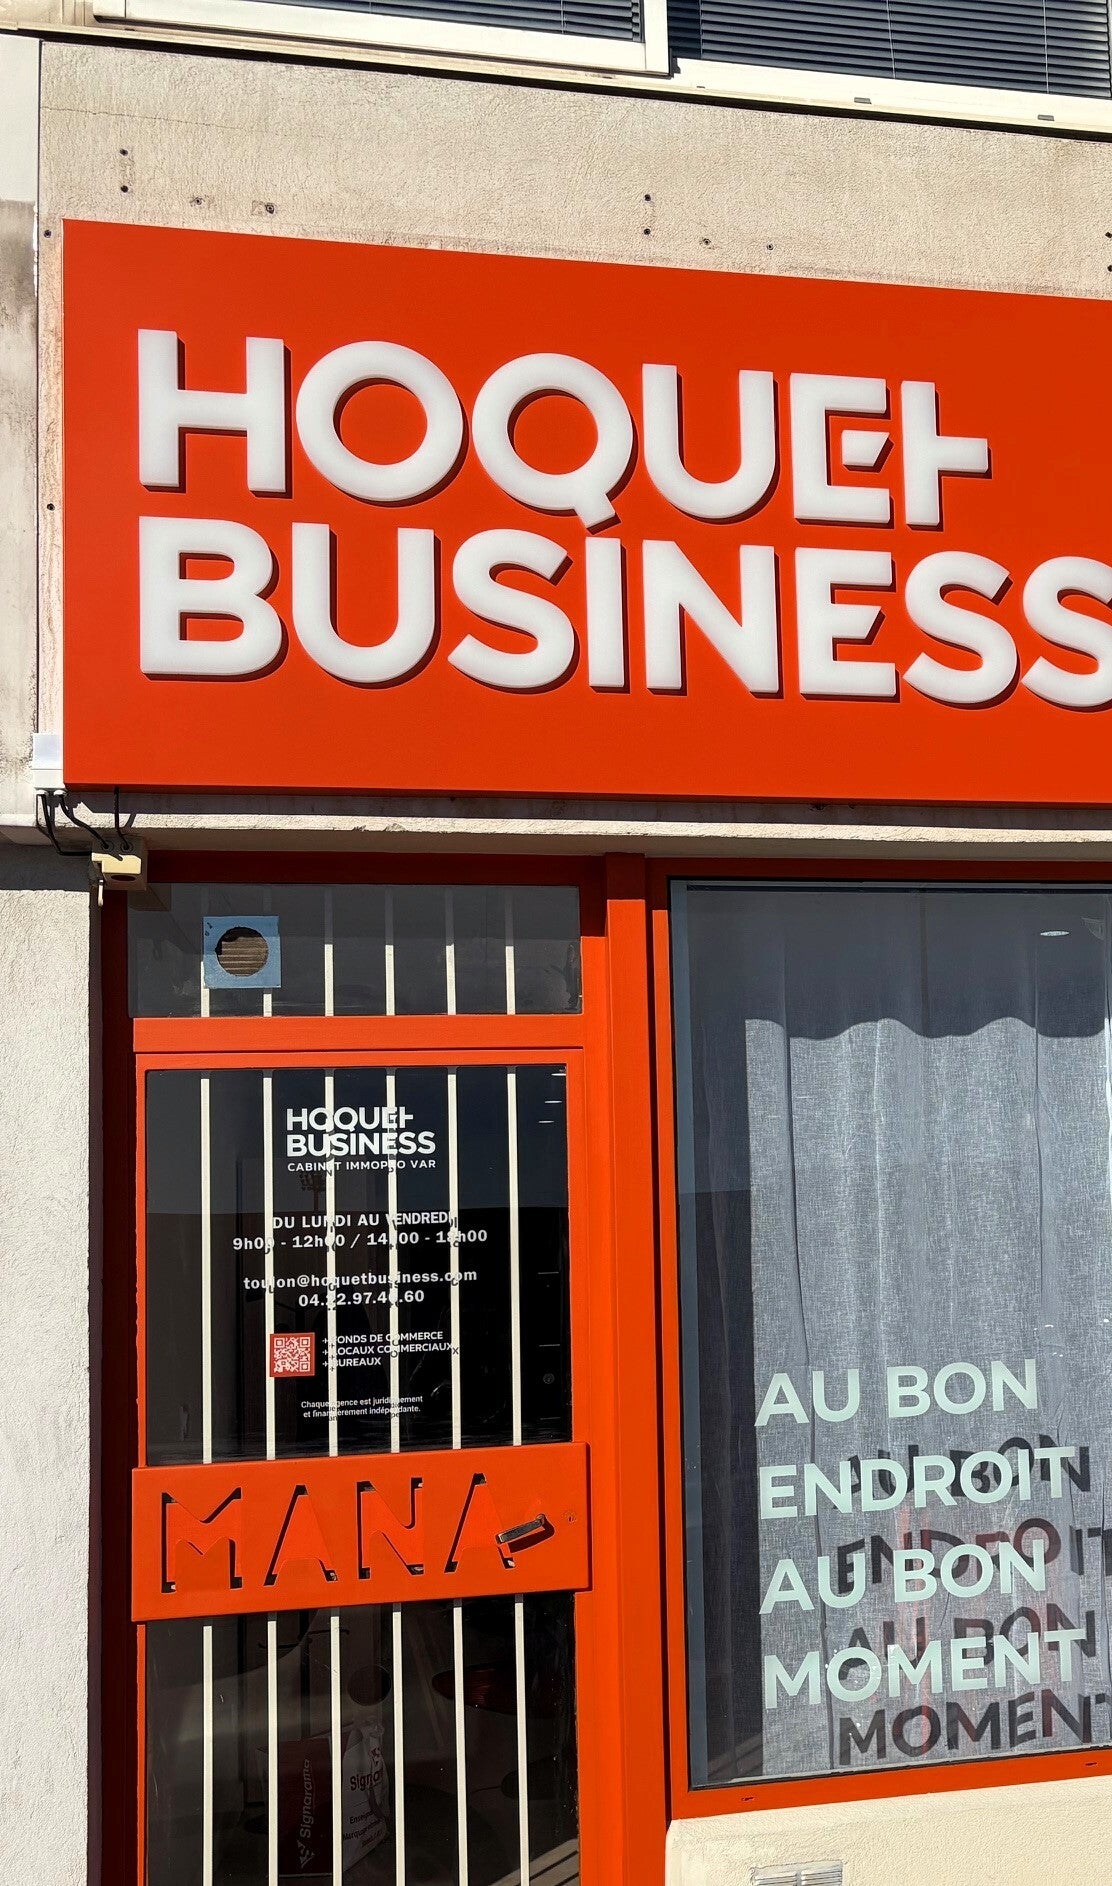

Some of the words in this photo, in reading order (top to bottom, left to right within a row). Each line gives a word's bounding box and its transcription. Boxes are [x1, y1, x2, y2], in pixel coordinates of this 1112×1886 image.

[286, 1131, 436, 1157] BUSINESS
[287, 1161, 341, 1172] CABINT
[346, 1160, 406, 1170] IMMOPO
[410, 1160, 436, 1169] VAR
[273, 1216, 295, 1229] DU
[357, 1214, 380, 1226] AU
[367, 1231, 419, 1246] 1400
[333, 1334, 367, 1344] ONDS
[369, 1333, 383, 1343] DE
[385, 1331, 443, 1342] CMMERCE
[333, 1346, 375, 1356] OCAUX
[377, 1342, 454, 1354] COMERCIAUX
[754, 1368, 860, 1427] AU
[886, 1358, 1038, 1418] BON
[331, 1399, 359, 1409] gence
[360, 1397, 371, 1405] est
[372, 1395, 423, 1407] juridiement
[303, 1410, 311, 1418] et
[312, 1407, 368, 1418] finanèrement
[369, 1405, 421, 1416] indépdante.
[758, 1446, 1076, 1519] ENDROIT
[759, 1551, 866, 1614] AU
[894, 1538, 1047, 1603] BON
[764, 1628, 1086, 1709] MOMENT
